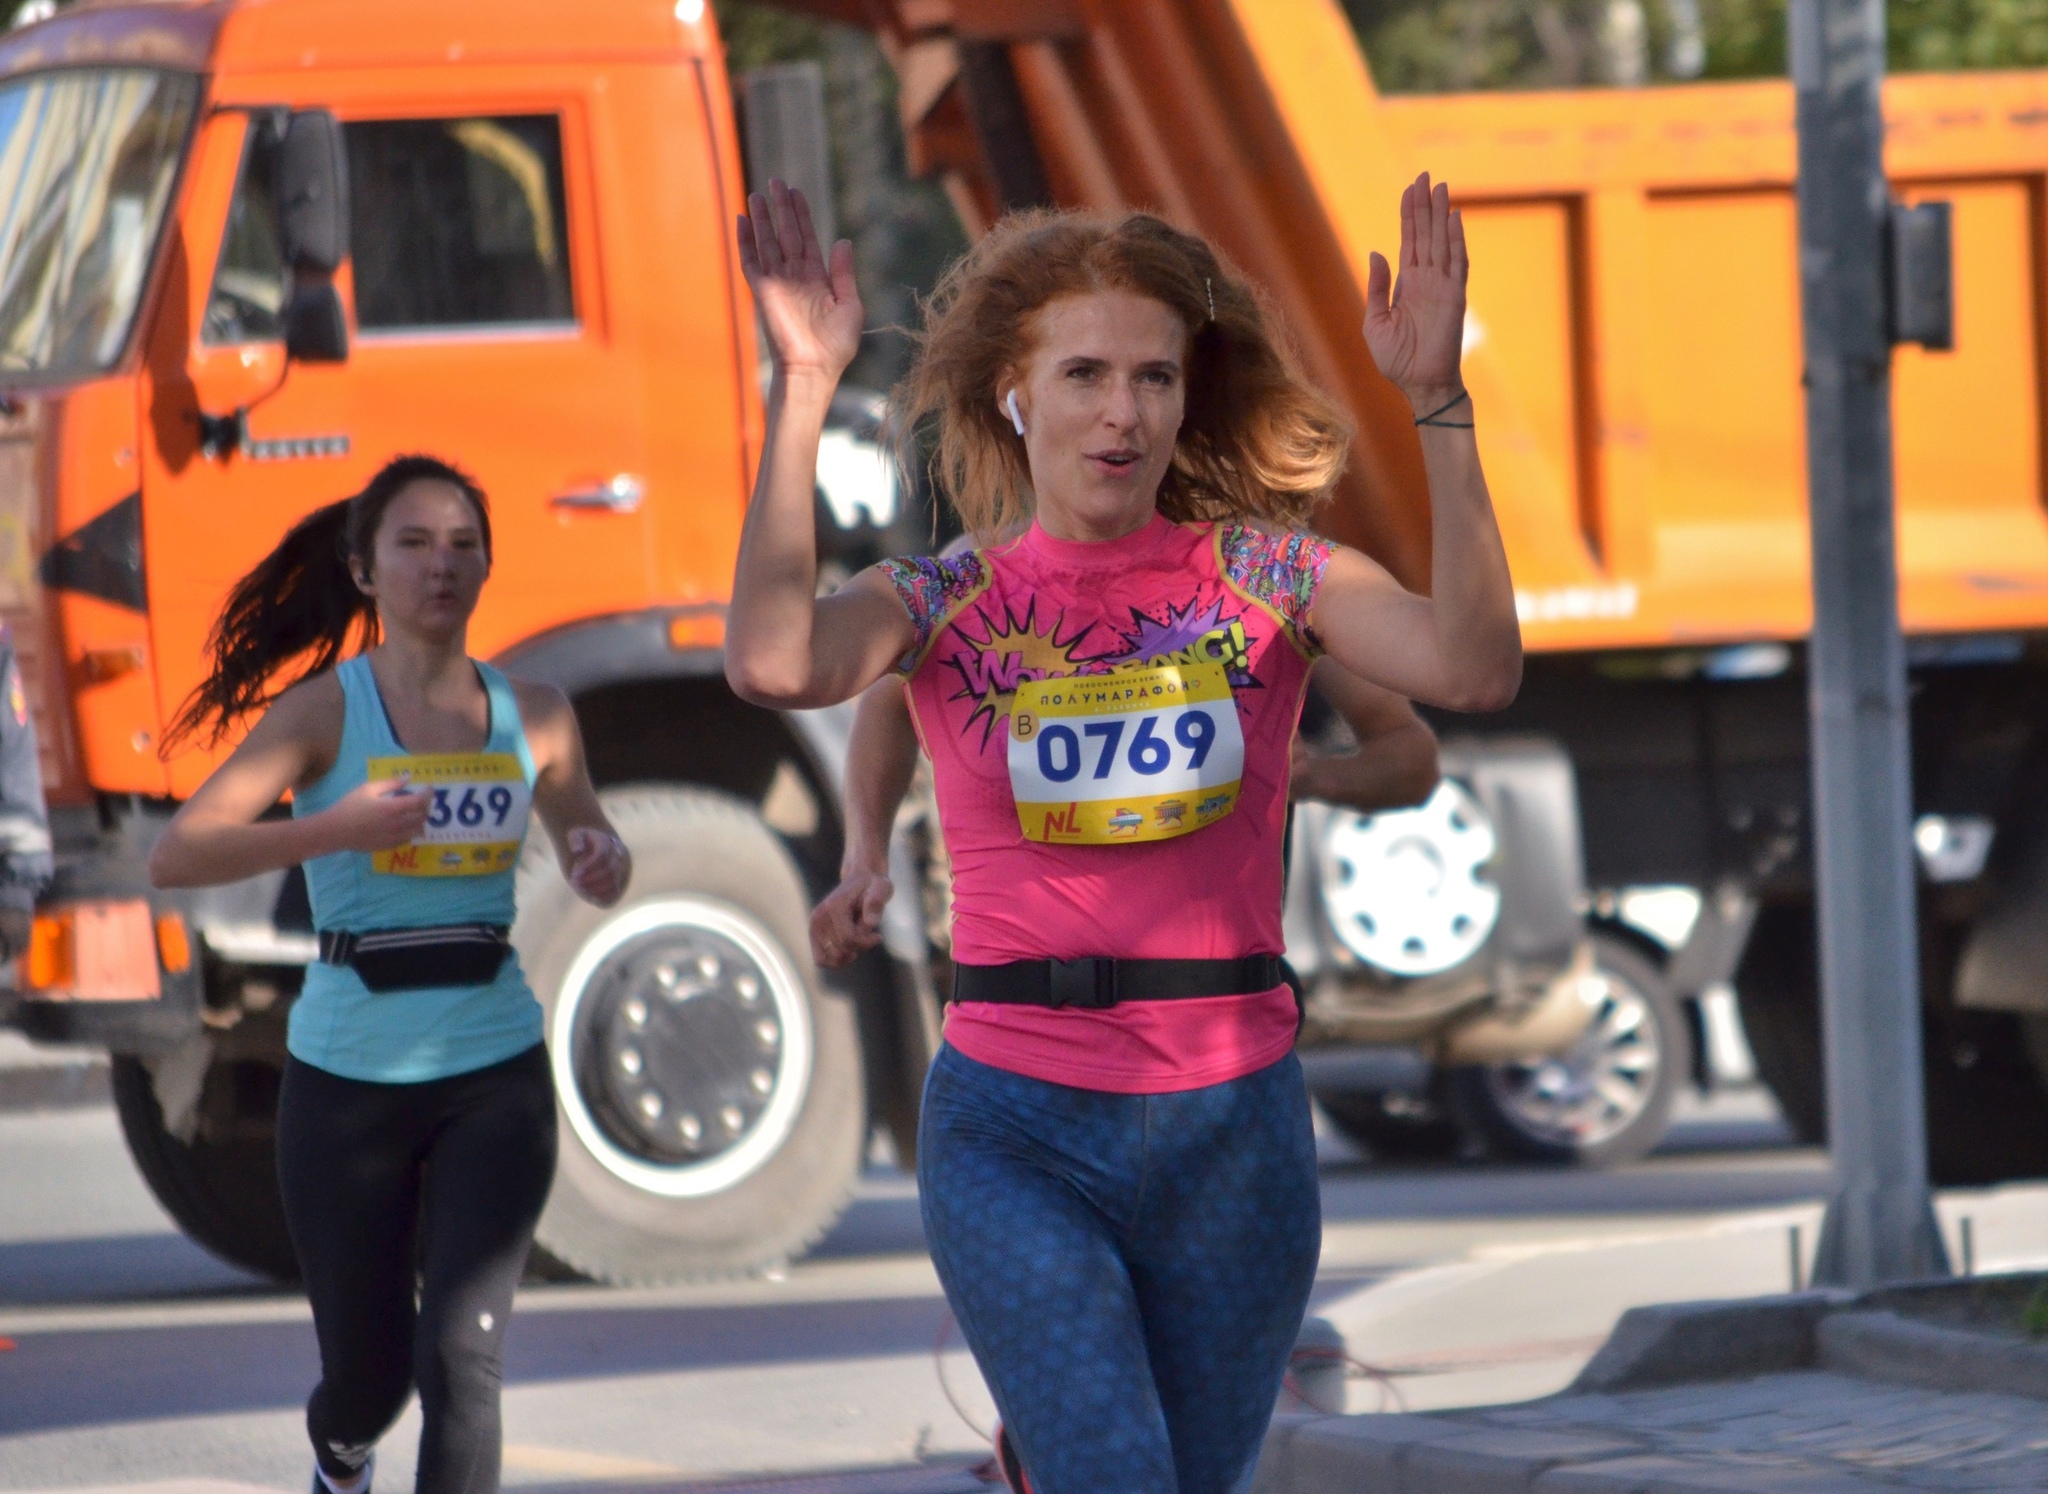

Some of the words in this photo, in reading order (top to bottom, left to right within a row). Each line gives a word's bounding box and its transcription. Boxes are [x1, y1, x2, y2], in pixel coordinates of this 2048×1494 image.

[1040, 681, 1190, 705] ПОЛУМАРАФОН
[1036, 710, 1216, 783] 0769
[393, 786, 512, 829] 369
[1042, 801, 1082, 841] NL
